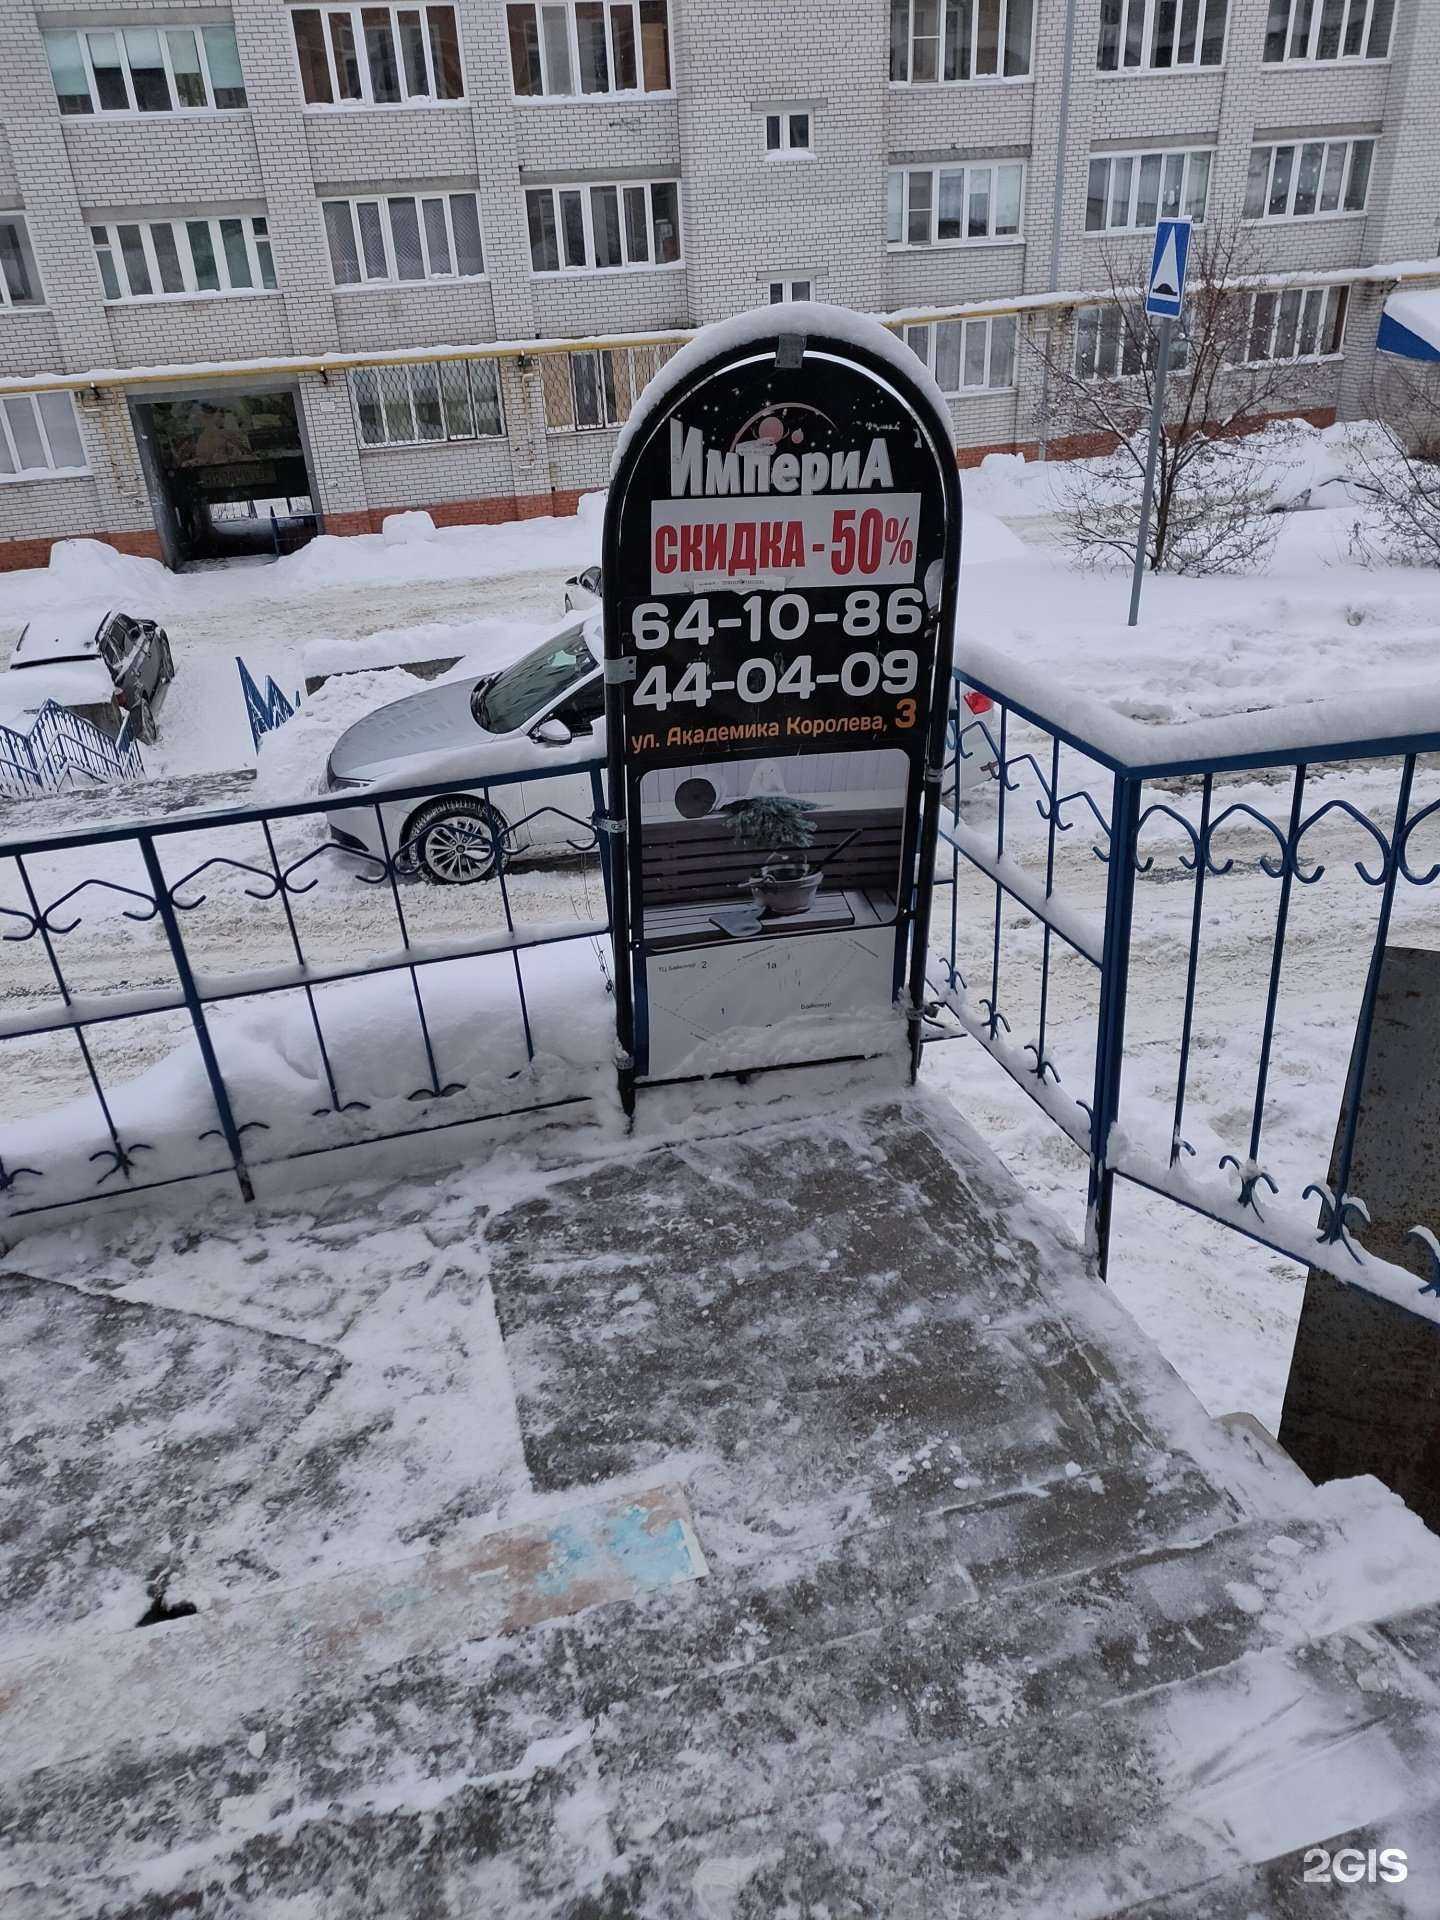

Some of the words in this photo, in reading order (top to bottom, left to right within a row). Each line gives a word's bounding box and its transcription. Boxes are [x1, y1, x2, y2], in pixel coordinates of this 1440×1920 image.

[655, 520, 806, 577] СКИДКА
[631, 588, 924, 650] 64-10-86
[632, 649, 919, 711] 44-04-09
[631, 735, 660, 754] ул.
[666, 722, 780, 747] Академика
[786, 715, 888, 738] Королева,
[895, 698, 918, 729] 3
[701, 960, 708, 969] 2
